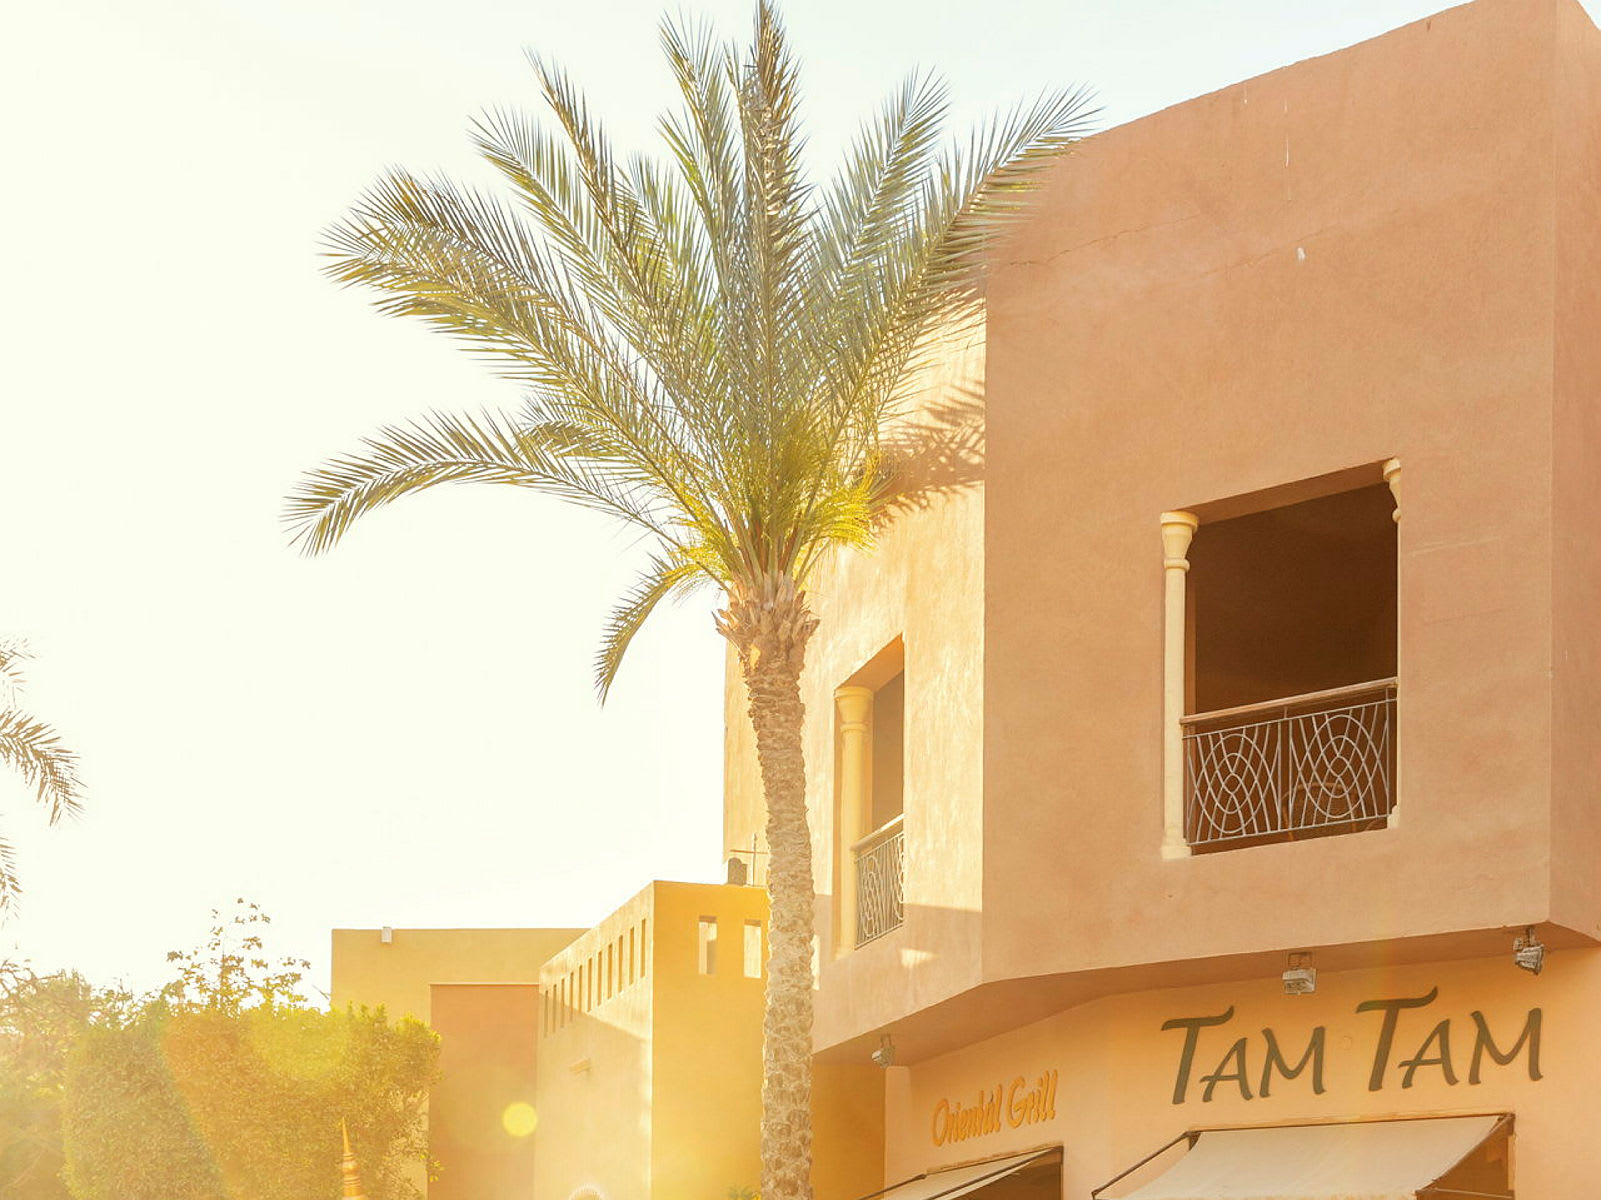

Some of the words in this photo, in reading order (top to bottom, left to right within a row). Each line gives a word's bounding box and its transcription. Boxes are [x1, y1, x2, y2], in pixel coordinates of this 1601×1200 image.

[1161, 1004, 1326, 1105] TAM
[1355, 985, 1543, 1092] TAM
[932, 1083, 1003, 1147] Oriental
[1006, 1068, 1058, 1129] Grill
